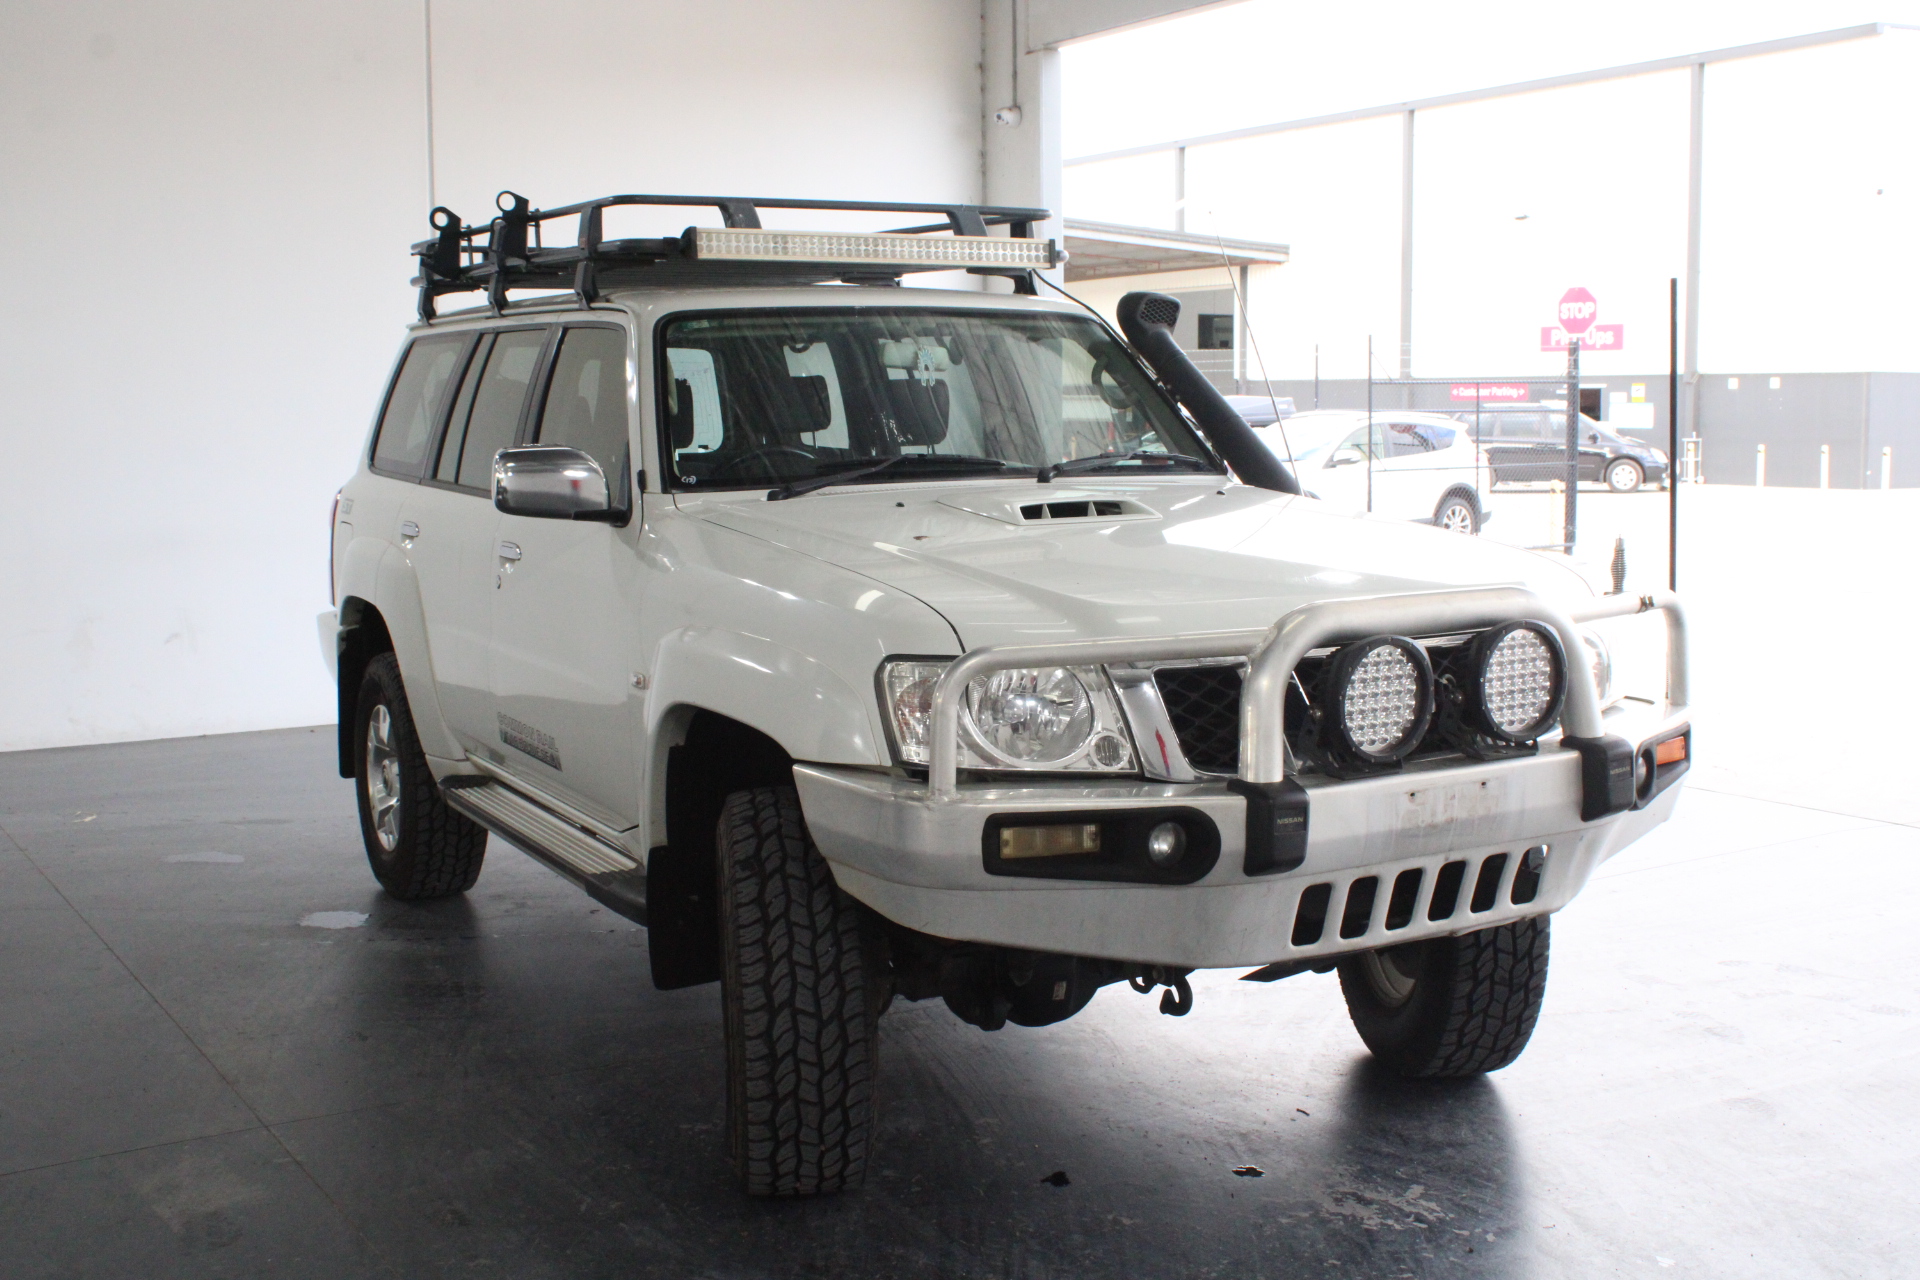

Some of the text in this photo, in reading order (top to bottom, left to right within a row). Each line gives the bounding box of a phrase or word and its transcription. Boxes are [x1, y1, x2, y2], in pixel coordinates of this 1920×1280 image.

[1560, 302, 1595, 319] STOP
[1551, 328, 1614, 348] Pi Ups
[1492, 386, 1518, 398] Parking
[1610, 766, 1631, 775] NISSAN
[1276, 816, 1304, 824] NISSAN
